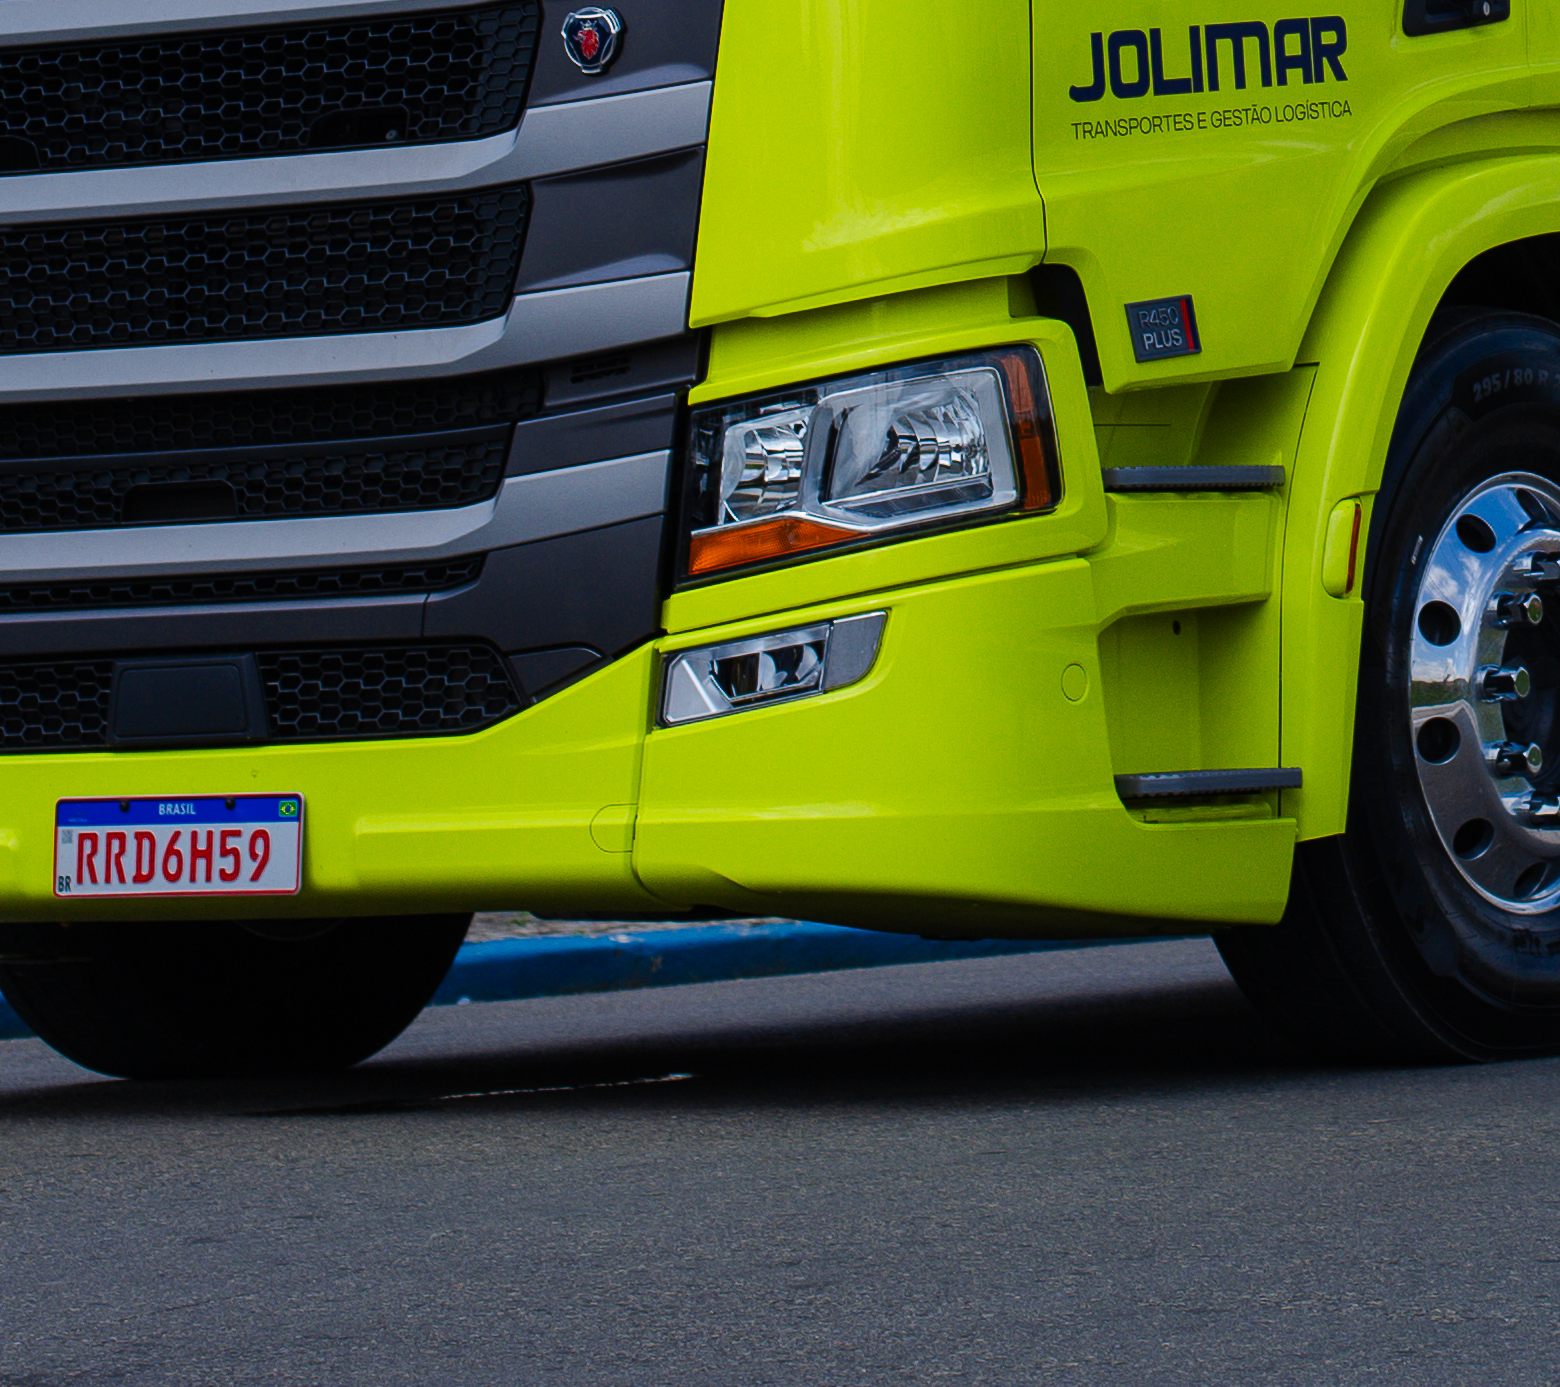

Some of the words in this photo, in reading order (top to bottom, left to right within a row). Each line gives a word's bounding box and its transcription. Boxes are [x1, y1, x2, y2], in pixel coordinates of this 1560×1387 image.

[1068, 15, 1349, 103] JOLIMAR
[1070, 112, 1194, 140] TRANSPORTES
[1197, 111, 1208, 130] E
[1210, 104, 1272, 129] GESTÃO
[1274, 99, 1352, 123] LOGÍSTICA
[1137, 305, 1179, 329] R450
[1142, 328, 1183, 351] PLUS
[1537, 368, 1550, 388] R
[158, 802, 196, 816] BRASIL
[75, 828, 272, 885] RRD6H59
[57, 875, 72, 893] BR
